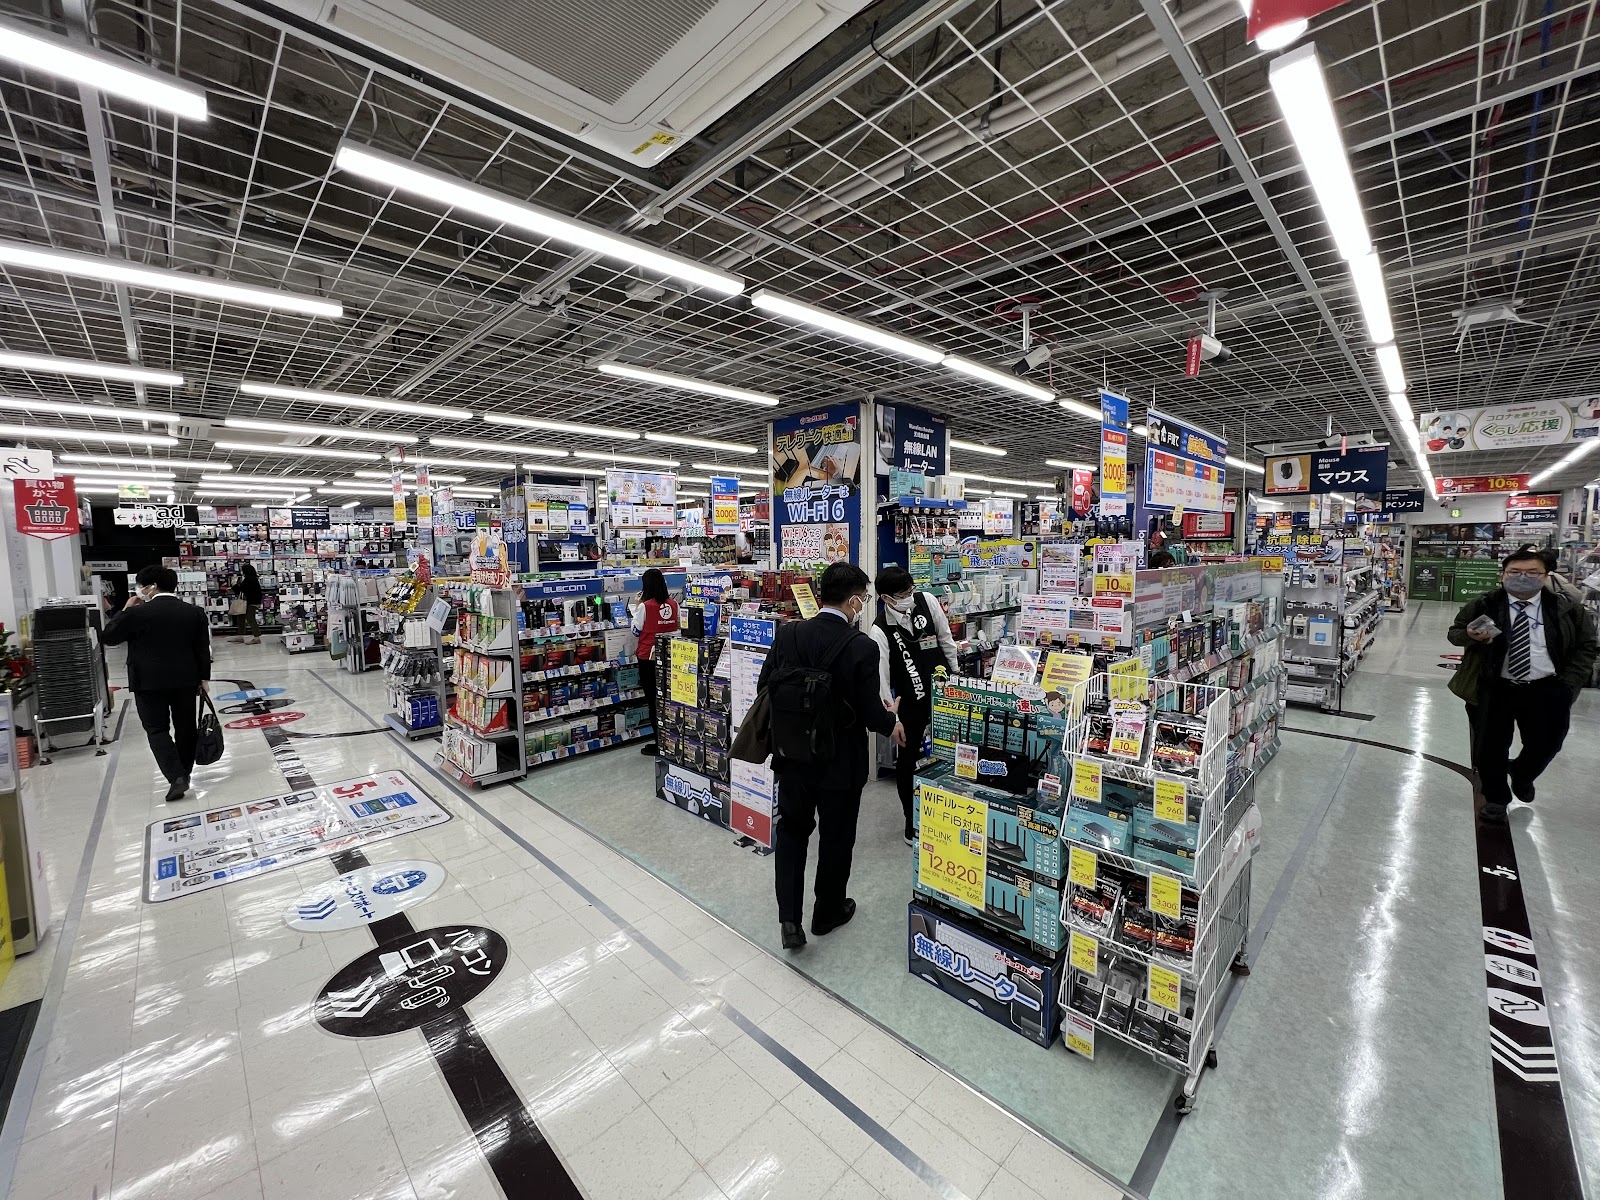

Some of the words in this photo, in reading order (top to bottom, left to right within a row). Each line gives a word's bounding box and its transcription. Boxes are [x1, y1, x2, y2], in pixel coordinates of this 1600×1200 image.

[1482, 418, 1560, 436] くらし応援
[904, 439, 938, 458] 無線LAN
[904, 457, 936, 471] ルーター
[25, 479, 65, 490] 買い物
[1317, 469, 1370, 485] マウス
[1488, 478, 1519, 489] 10%
[32, 489, 59, 498] かご
[784, 485, 849, 503] 無線ルーターは
[787, 500, 829, 523] Wi-Fi
[831, 499, 845, 522] 6
[1385, 501, 1422, 509] PCソフト
[1266, 535, 1323, 545] 抗菌・除菌
[1293, 545, 1333, 553] キーボード
[543, 584, 587, 593] ELECOM
[737, 627, 767, 636] インターネット
[893, 631, 906, 652] BIC
[902, 650, 926, 701] CAMERA
[666, 775, 722, 807] 無線ルーター
[923, 790, 984, 815] WiFiルーター
[923, 805, 983, 834] Wi-Fi6対応
[922, 824, 952, 842] TPLINK
[445, 928, 492, 975] パソコン
[916, 934, 1038, 1008] 無線ルーター
